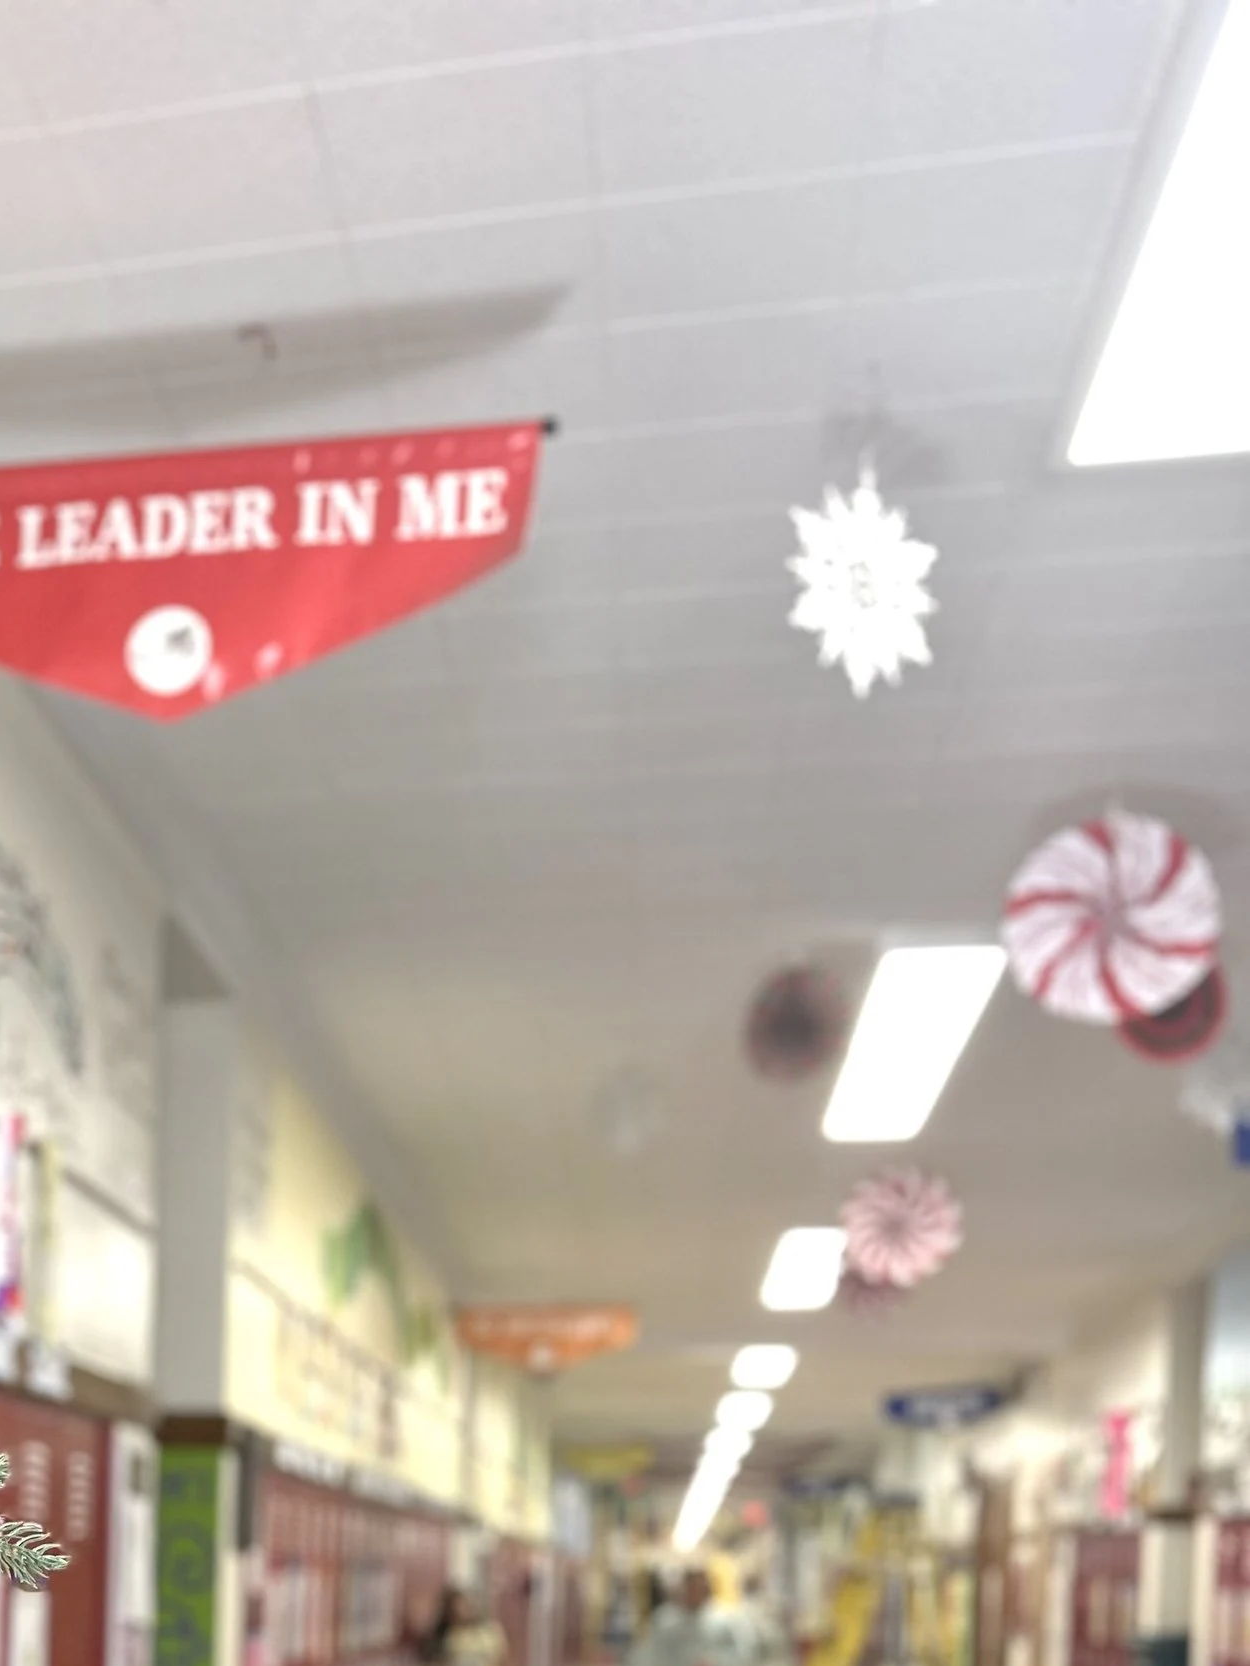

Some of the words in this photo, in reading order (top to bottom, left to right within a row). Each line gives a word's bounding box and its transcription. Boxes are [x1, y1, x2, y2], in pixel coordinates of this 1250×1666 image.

[16, 487, 278, 569] LEADER
[295, 478, 380, 546] IN
[395, 467, 509, 542] ME
